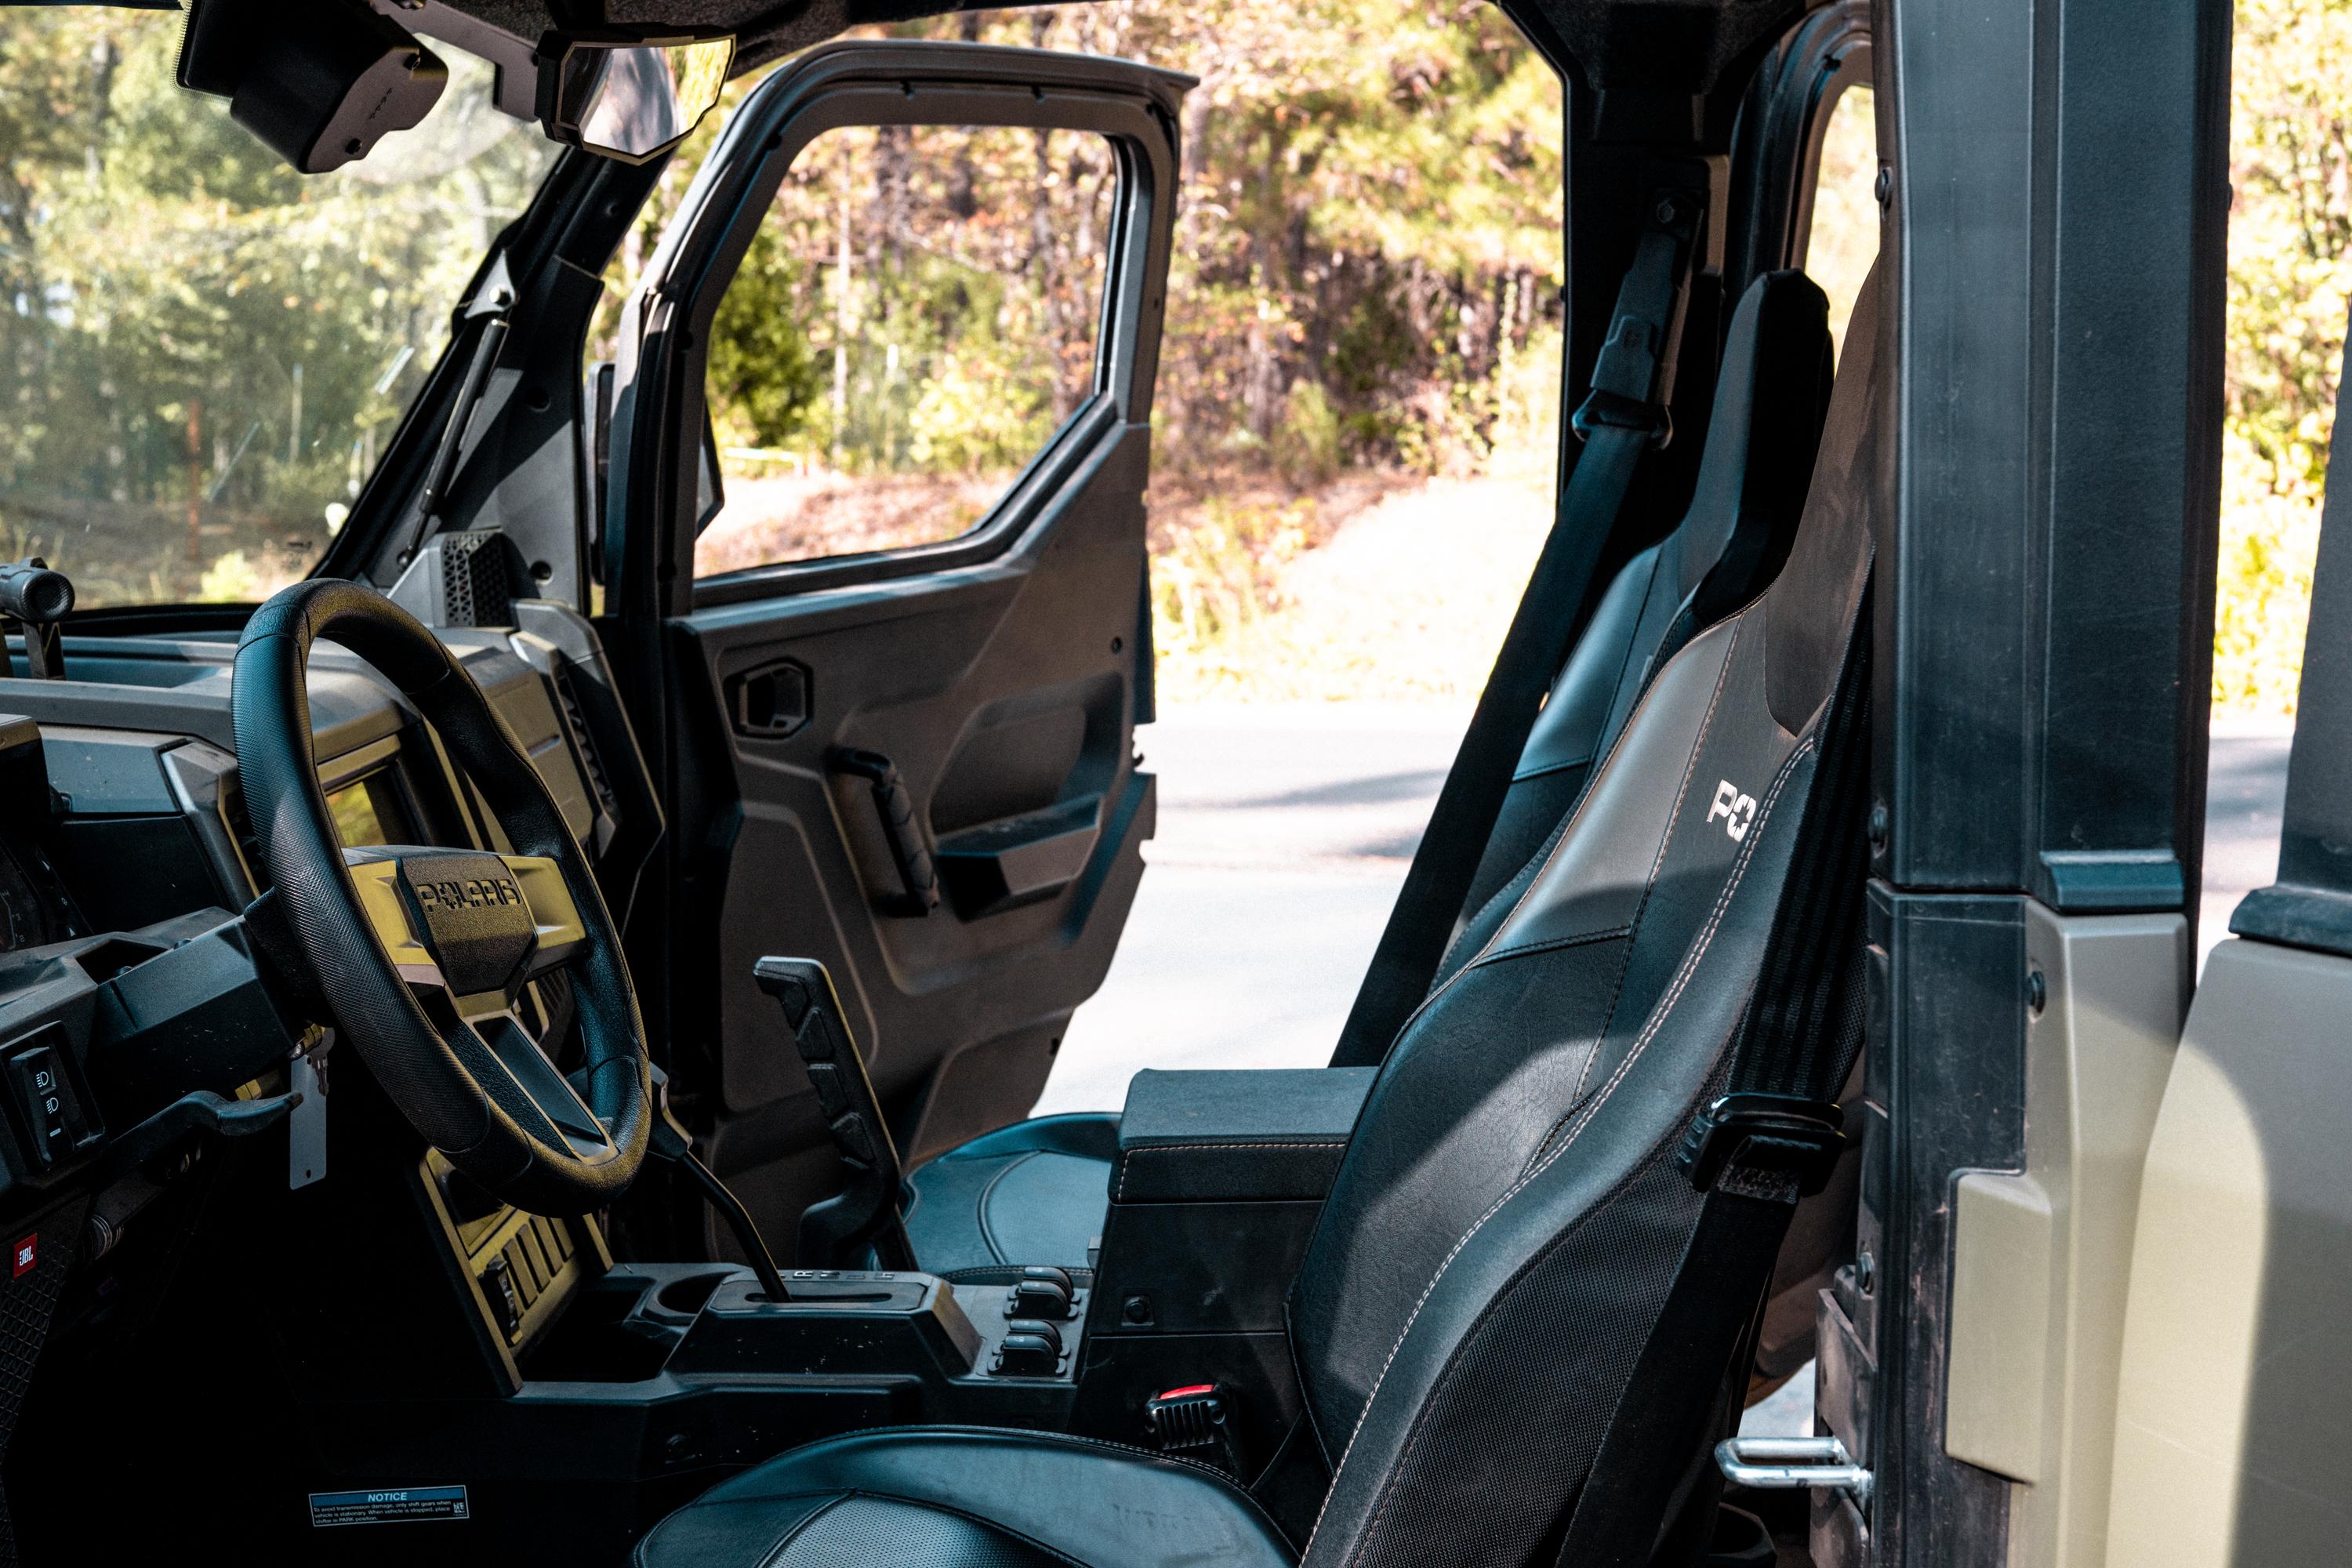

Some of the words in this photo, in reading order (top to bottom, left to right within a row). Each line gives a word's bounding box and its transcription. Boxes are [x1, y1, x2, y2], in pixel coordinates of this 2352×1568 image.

[416, 880, 520, 912] POLARIS
[19, 1245, 34, 1266] JBL
[368, 1492, 408, 1502] NOTICE
